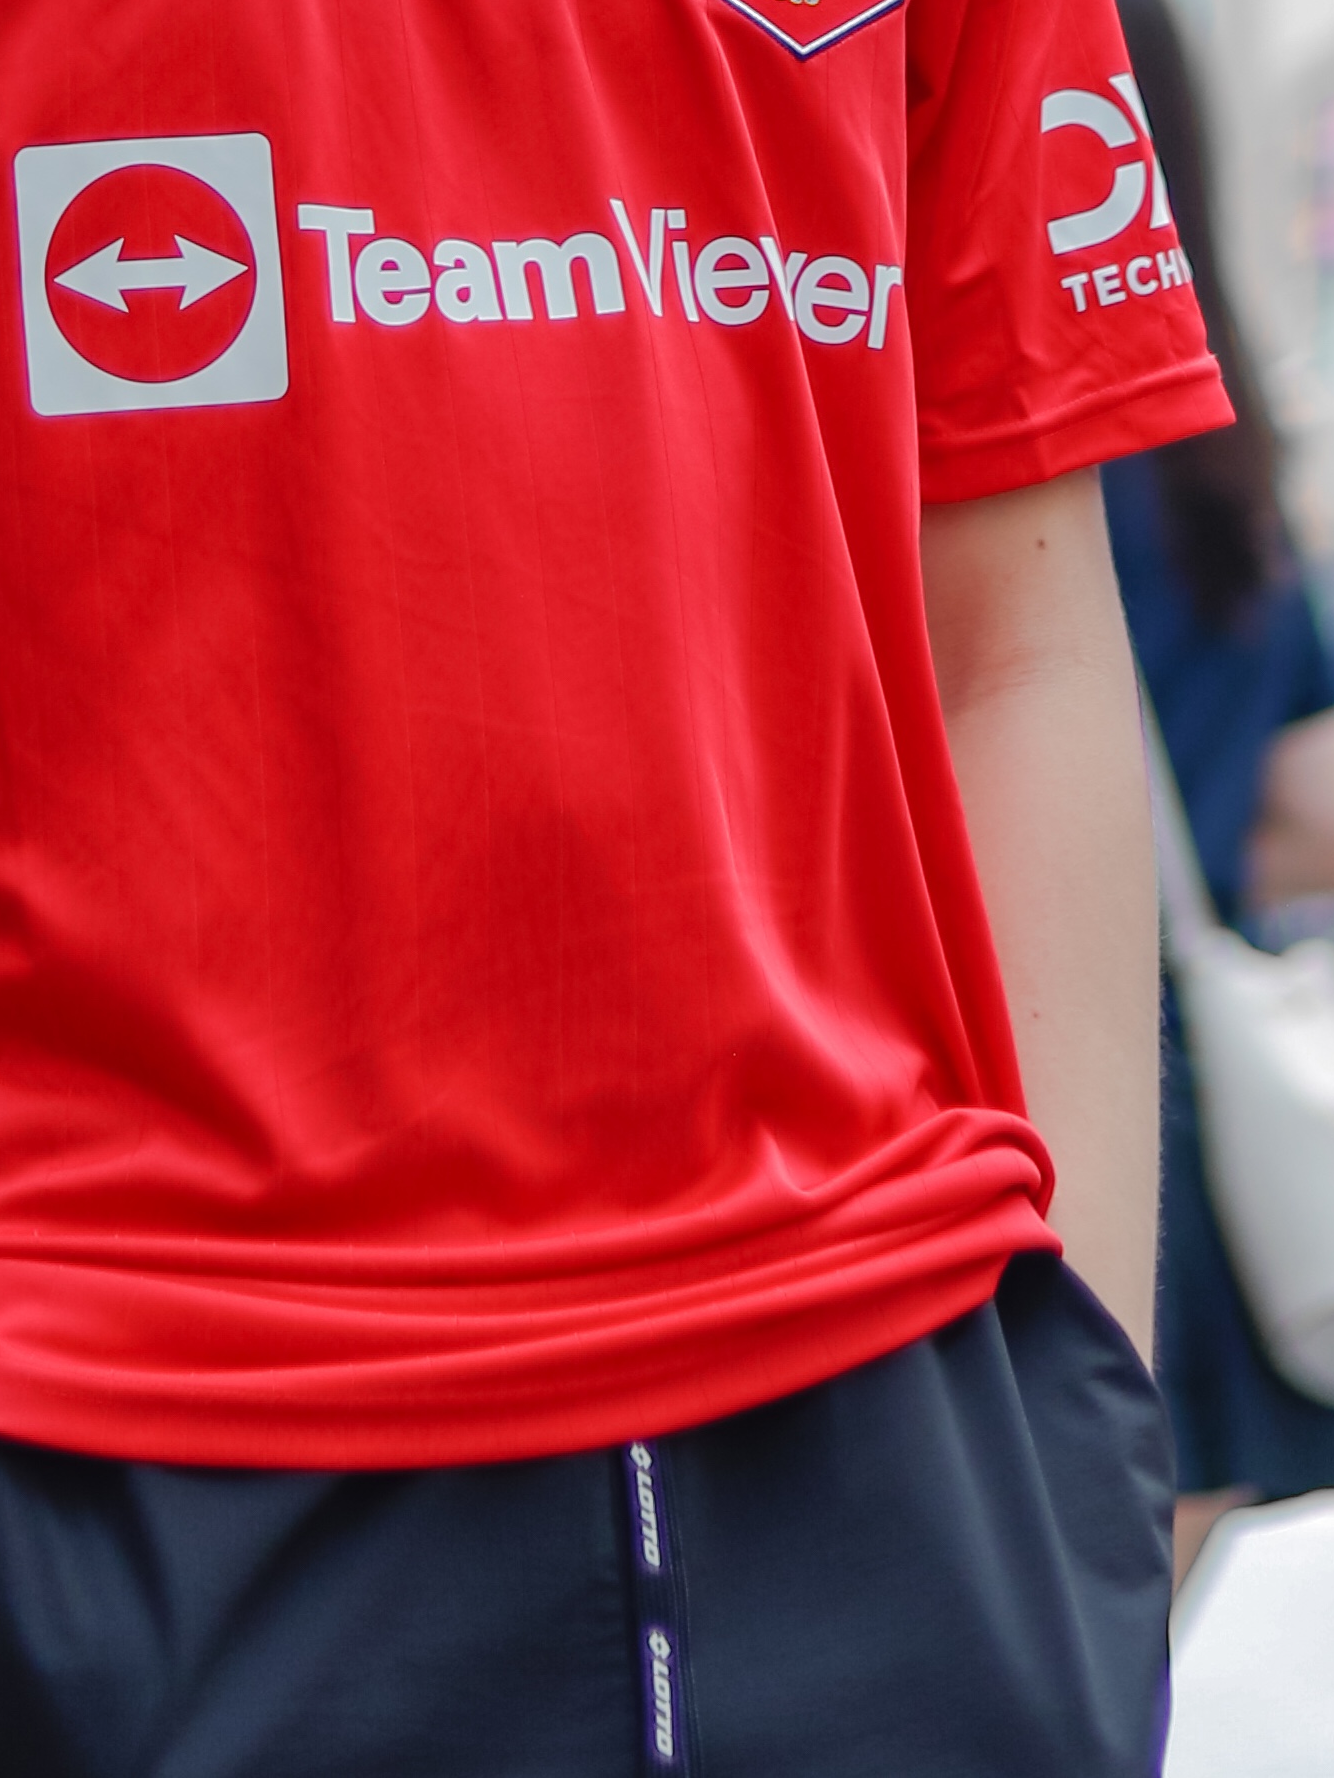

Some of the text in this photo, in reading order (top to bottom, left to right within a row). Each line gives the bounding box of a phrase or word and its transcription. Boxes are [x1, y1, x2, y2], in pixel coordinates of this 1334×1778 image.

[297, 198, 903, 351] TeamViewer
[636, 1471, 661, 1568] LOTTO
[653, 1660, 674, 1758] LOTTO
